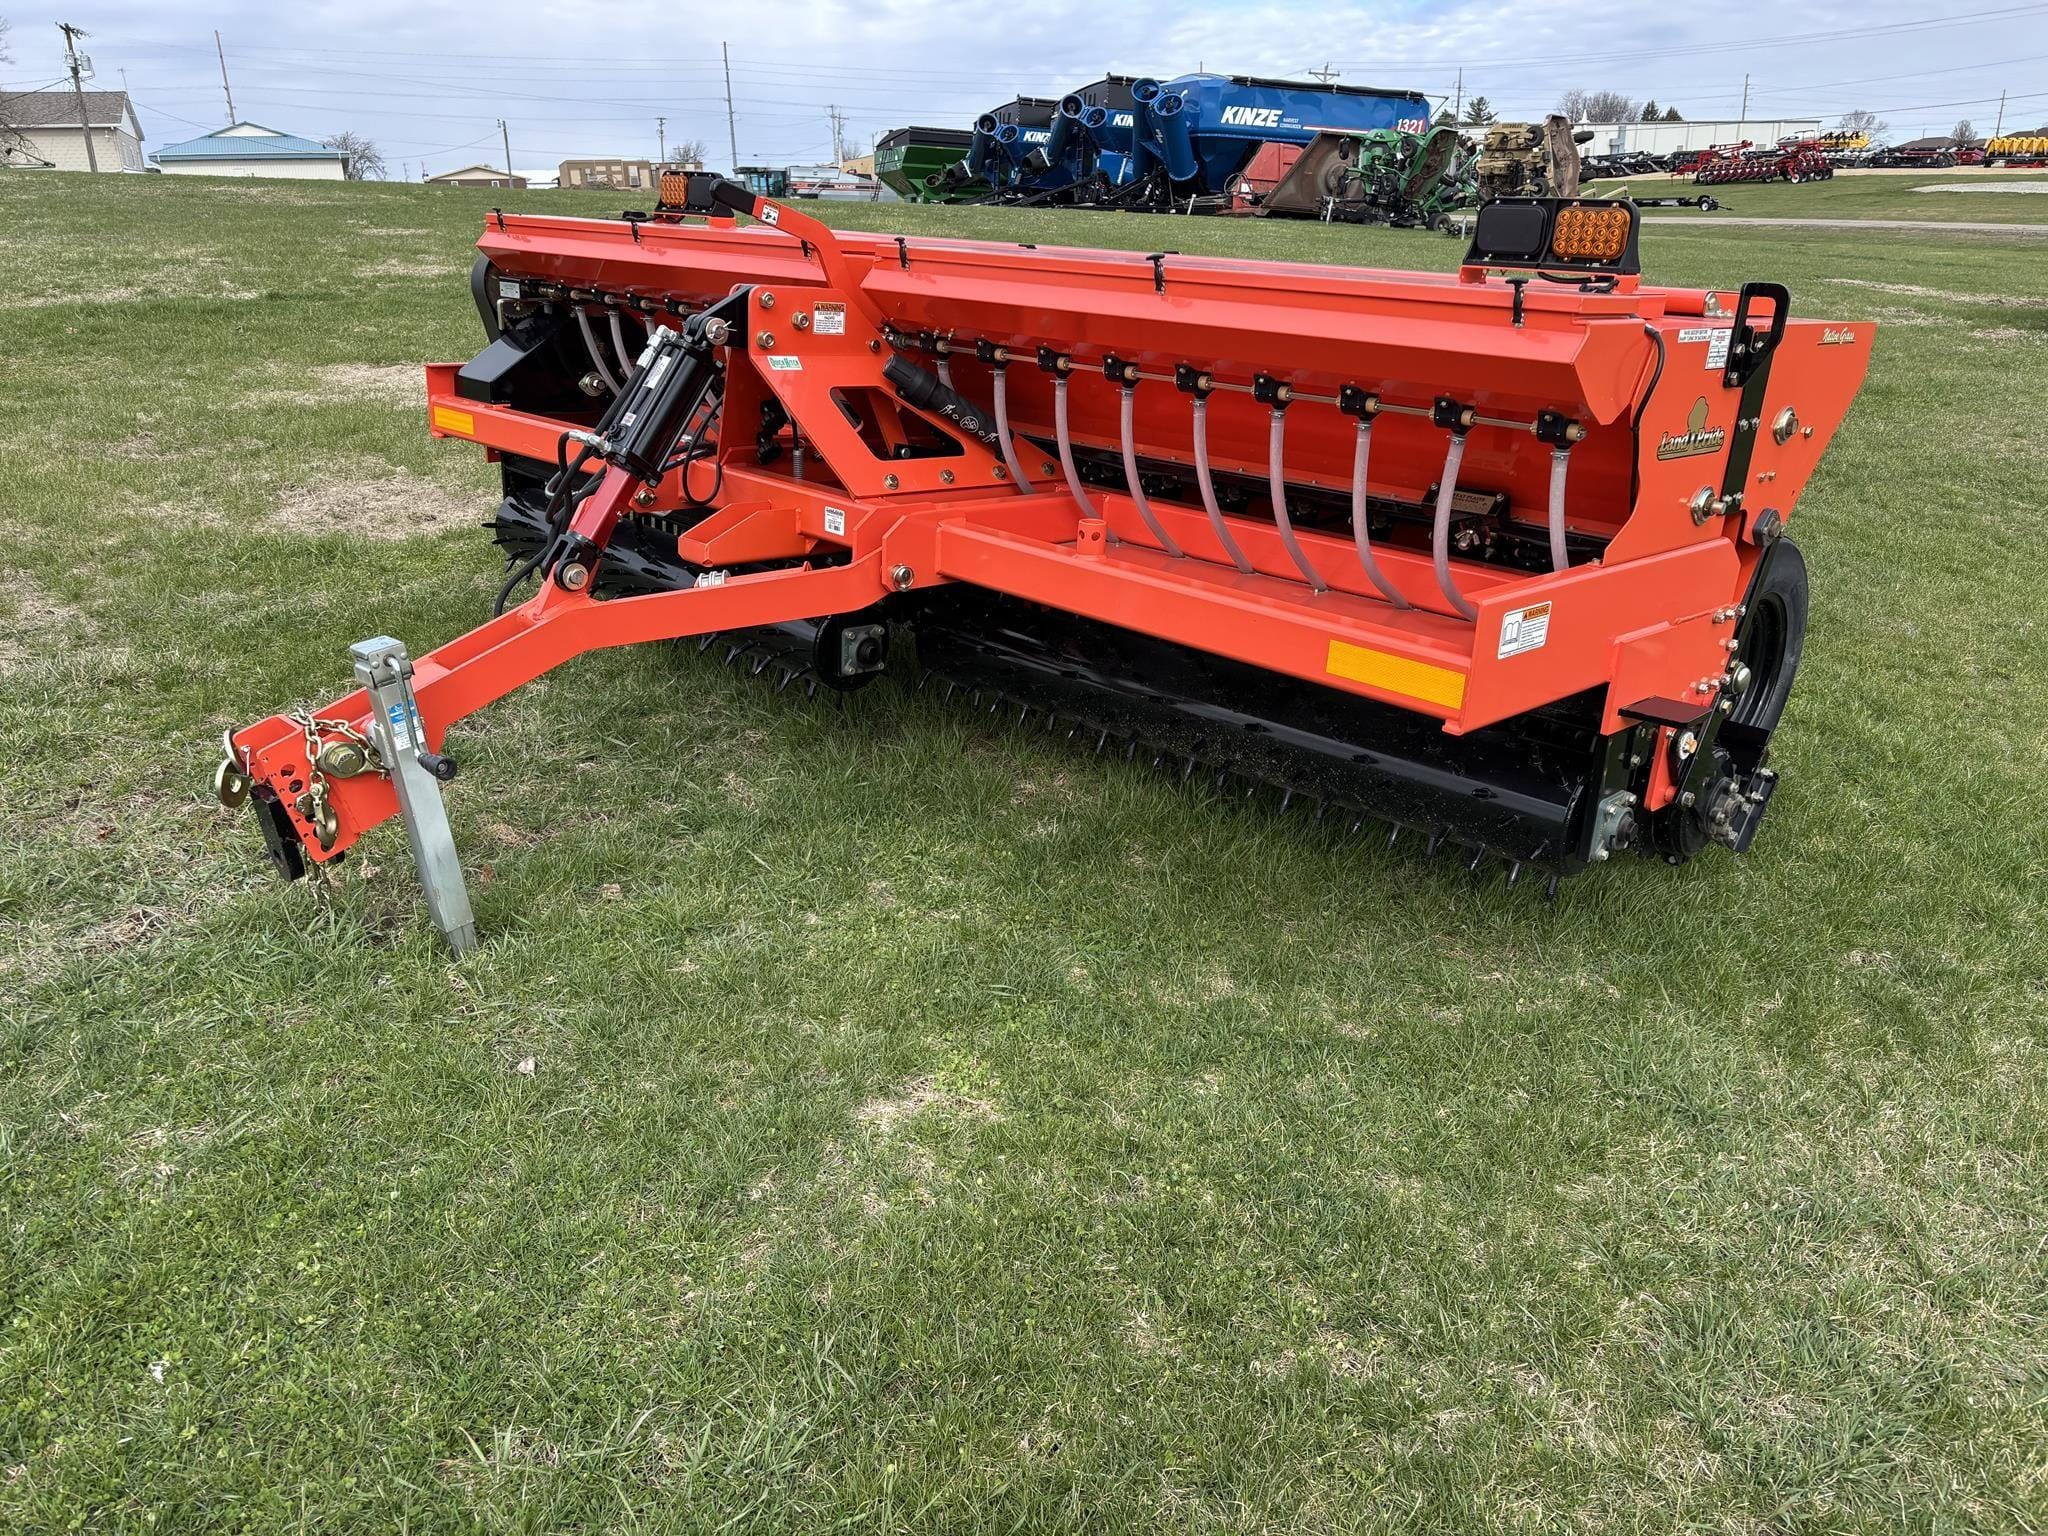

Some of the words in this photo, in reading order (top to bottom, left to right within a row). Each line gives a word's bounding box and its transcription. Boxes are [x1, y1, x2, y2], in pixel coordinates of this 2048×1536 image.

[1112, 114, 1133, 127] KIN
[1220, 106, 1283, 128] KINZE
[1397, 118, 1424, 133] 1321
[1023, 130, 1051, 143] KINZ
[1659, 431, 1690, 452] Land
[1694, 426, 1725, 449] Pride
